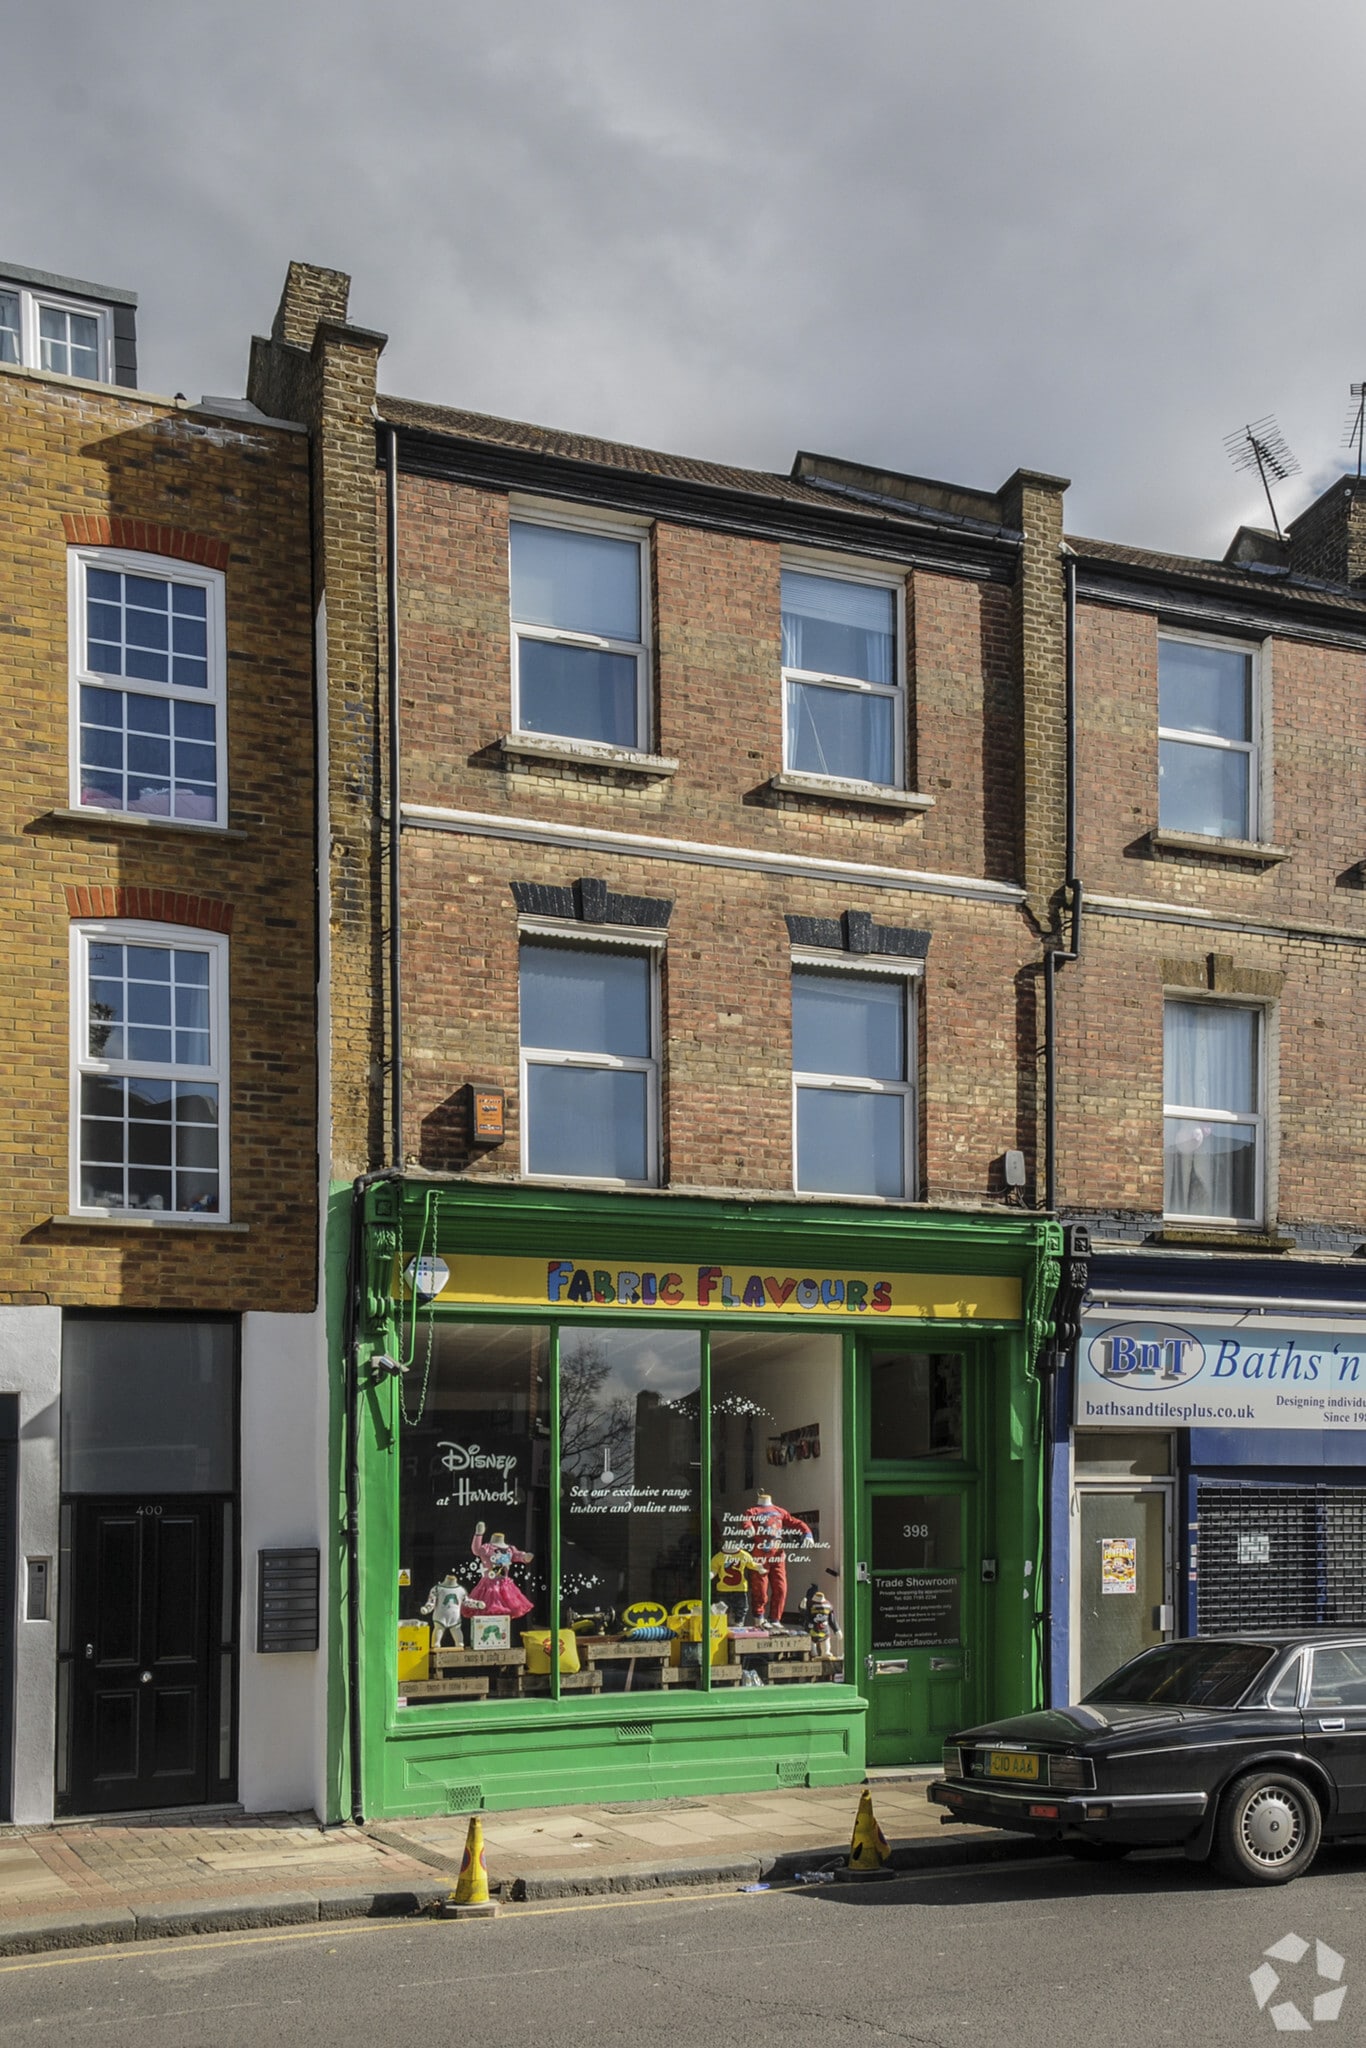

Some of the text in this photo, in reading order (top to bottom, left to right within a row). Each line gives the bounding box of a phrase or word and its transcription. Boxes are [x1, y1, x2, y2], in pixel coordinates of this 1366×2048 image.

[547, 1260, 893, 1312] FABRIC FLAVOURS
[1108, 1334, 1194, 1376] BnT
[1210, 1339, 1322, 1381] Baths
[1276, 1395, 1325, 1409] Designing
[1086, 1401, 1255, 1421] bathsandtilesplus.co.uk
[1323, 1411, 1366, 1423] Since 19
[436, 1441, 517, 1479] Disney
[570, 1486, 692, 1500] See our exclusive range
[436, 1496, 450, 1506] at
[570, 1501, 692, 1514] instore and online now.
[136, 1505, 163, 1516] 400
[722, 1526, 803, 1538] Disney Prinesses,
[903, 1524, 929, 1538] 398
[722, 1540, 755, 1551] Mickey
[800, 1540, 831, 1549] Mouse,
[723, 1555, 740, 1566] Toy
[742, 1554, 767, 1565] Sory
[787, 1553, 812, 1563] Cars.
[875, 1577, 957, 1588] Trade Showroom
[873, 1638, 959, 1648] www.fabricflavours.com
